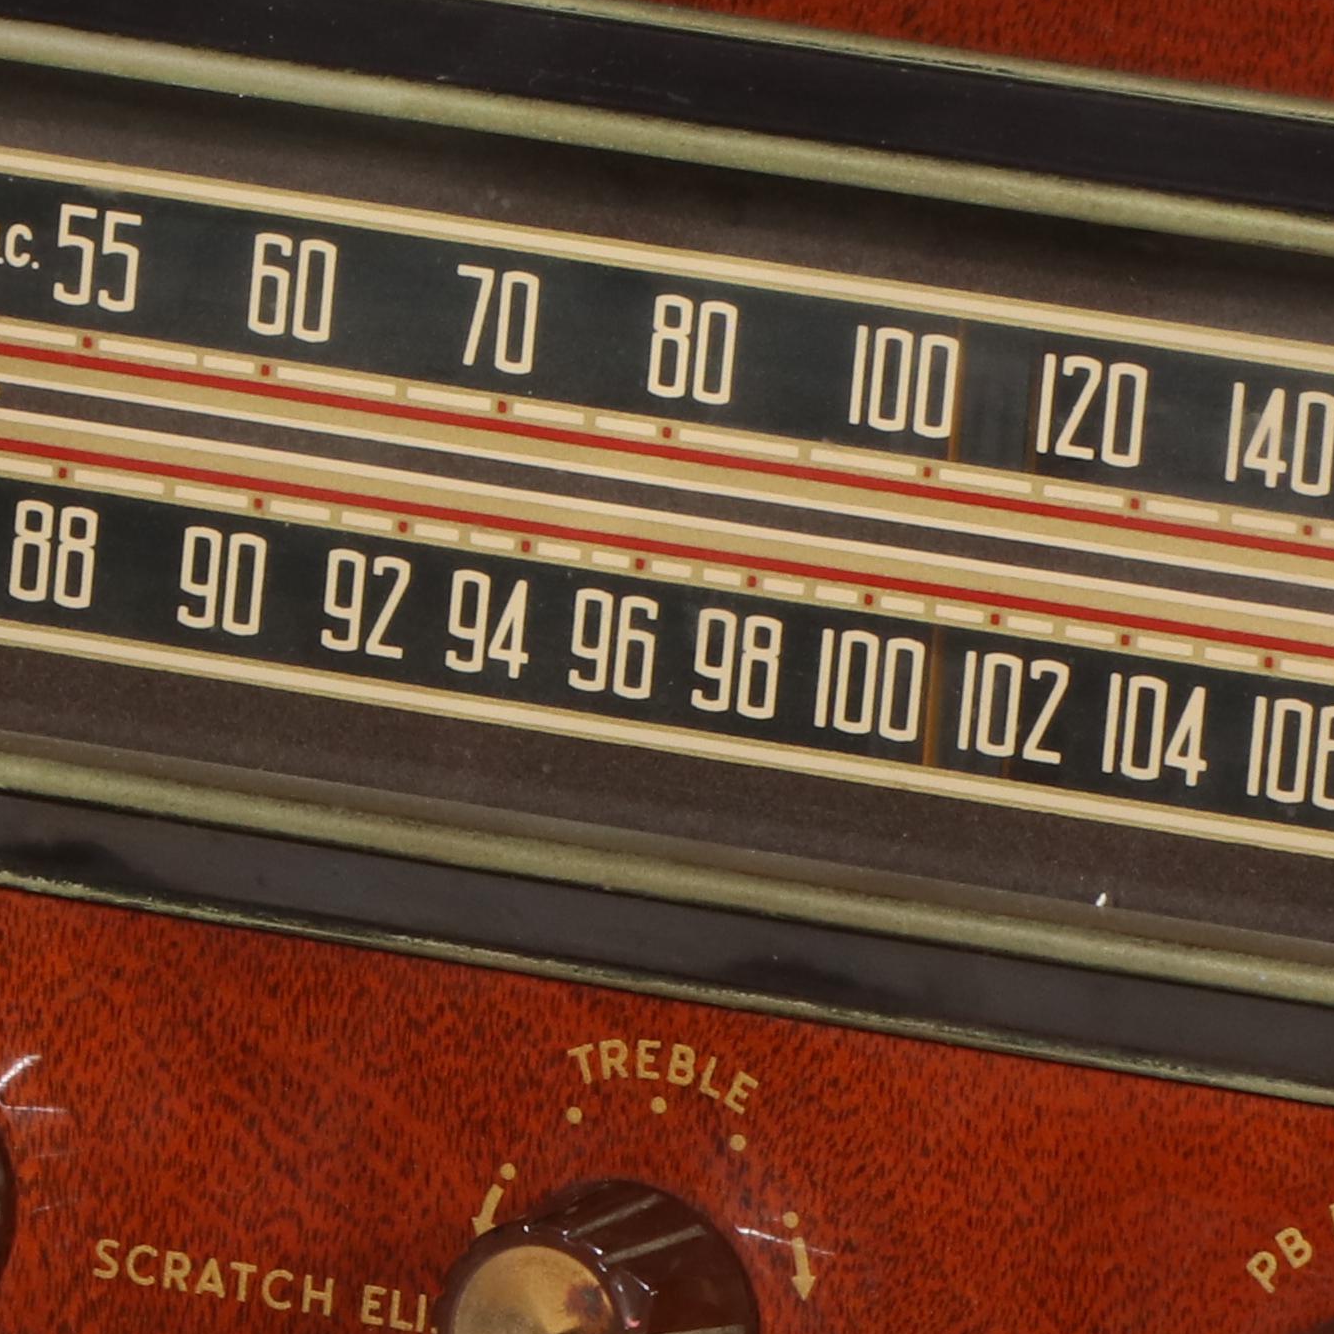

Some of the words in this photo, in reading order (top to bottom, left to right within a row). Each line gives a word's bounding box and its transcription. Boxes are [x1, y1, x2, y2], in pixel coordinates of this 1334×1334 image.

[53, 203, 142, 313] 55
[247, 232, 338, 343] 60
[457, 264, 540, 375] 70
[647, 294, 738, 405] 80
[848, 325, 960, 439] 100
[1036, 353, 1148, 468] 120
[8, 499, 99, 609] 88
[177, 526, 267, 636] 90
[321, 548, 411, 660] 92
[445, 569, 529, 679] 94
[568, 588, 659, 700] 96
[691, 607, 783, 720] 98
[814, 628, 926, 742] 100
[957, 650, 1070, 765] 102
[1101, 672, 1208, 787] 104
[566, 1038, 759, 1115] TREBLE
[92, 1238, 334, 1316] SCRATCH
[1246, 1227, 1313, 1293] PB
